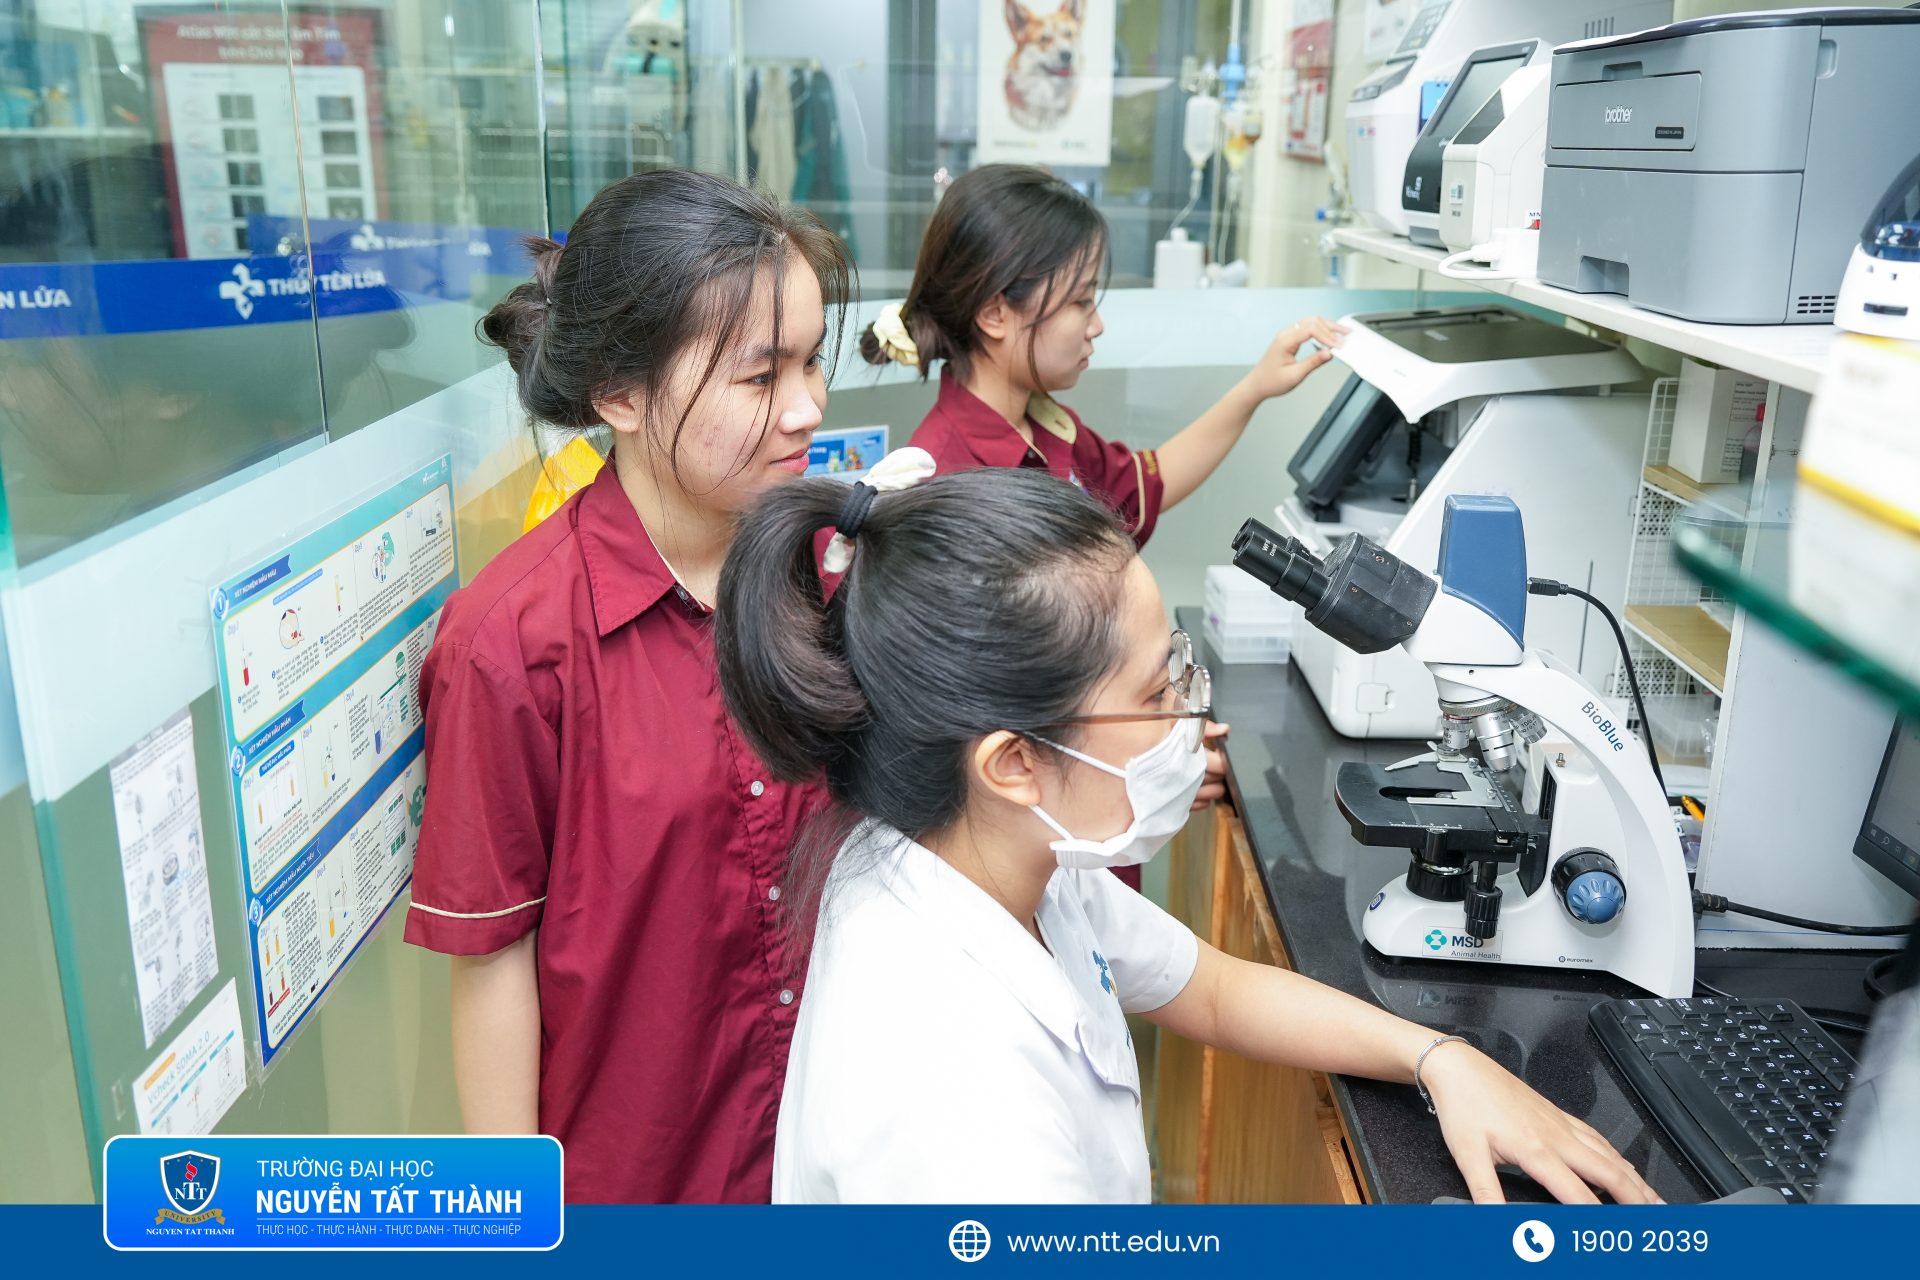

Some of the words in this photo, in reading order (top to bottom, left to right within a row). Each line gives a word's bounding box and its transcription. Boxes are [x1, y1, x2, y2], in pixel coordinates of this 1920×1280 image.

[1605, 106, 1632, 123] brother
[19, 284, 73, 309] LỬA
[1581, 700, 1624, 752] BioBlue
[1451, 934, 1484, 948] MSD
[1450, 949, 1477, 959] Animal
[1477, 951, 1501, 960] Health
